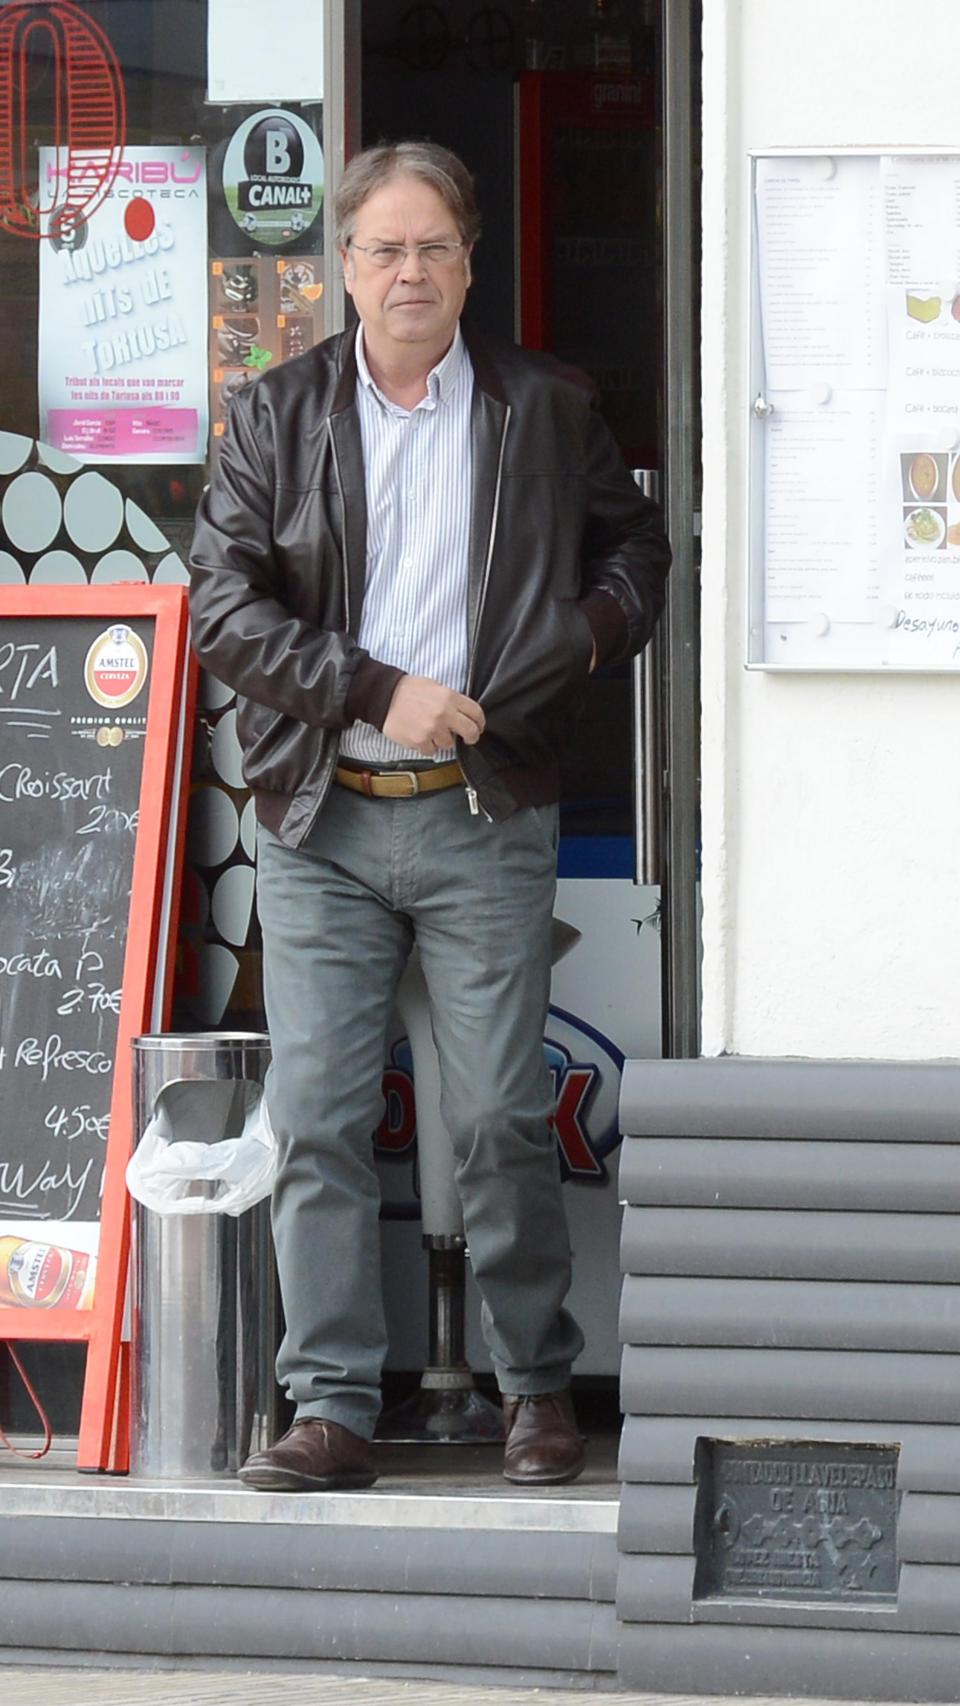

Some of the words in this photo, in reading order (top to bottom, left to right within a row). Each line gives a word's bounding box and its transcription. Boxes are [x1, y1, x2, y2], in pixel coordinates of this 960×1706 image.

[592, 82, 641, 108] granini
[266, 130, 291, 174] B
[248, 185, 312, 207] CANAL+
[65, 376, 87, 387] Tribut
[157, 378, 184, 388] marcar
[98, 658, 136, 668] AMSTEL
[70, 716, 111, 725] PREMIUM
[14, 1034, 112, 1081] Refresco
[770, 1487, 793, 1512] DE
